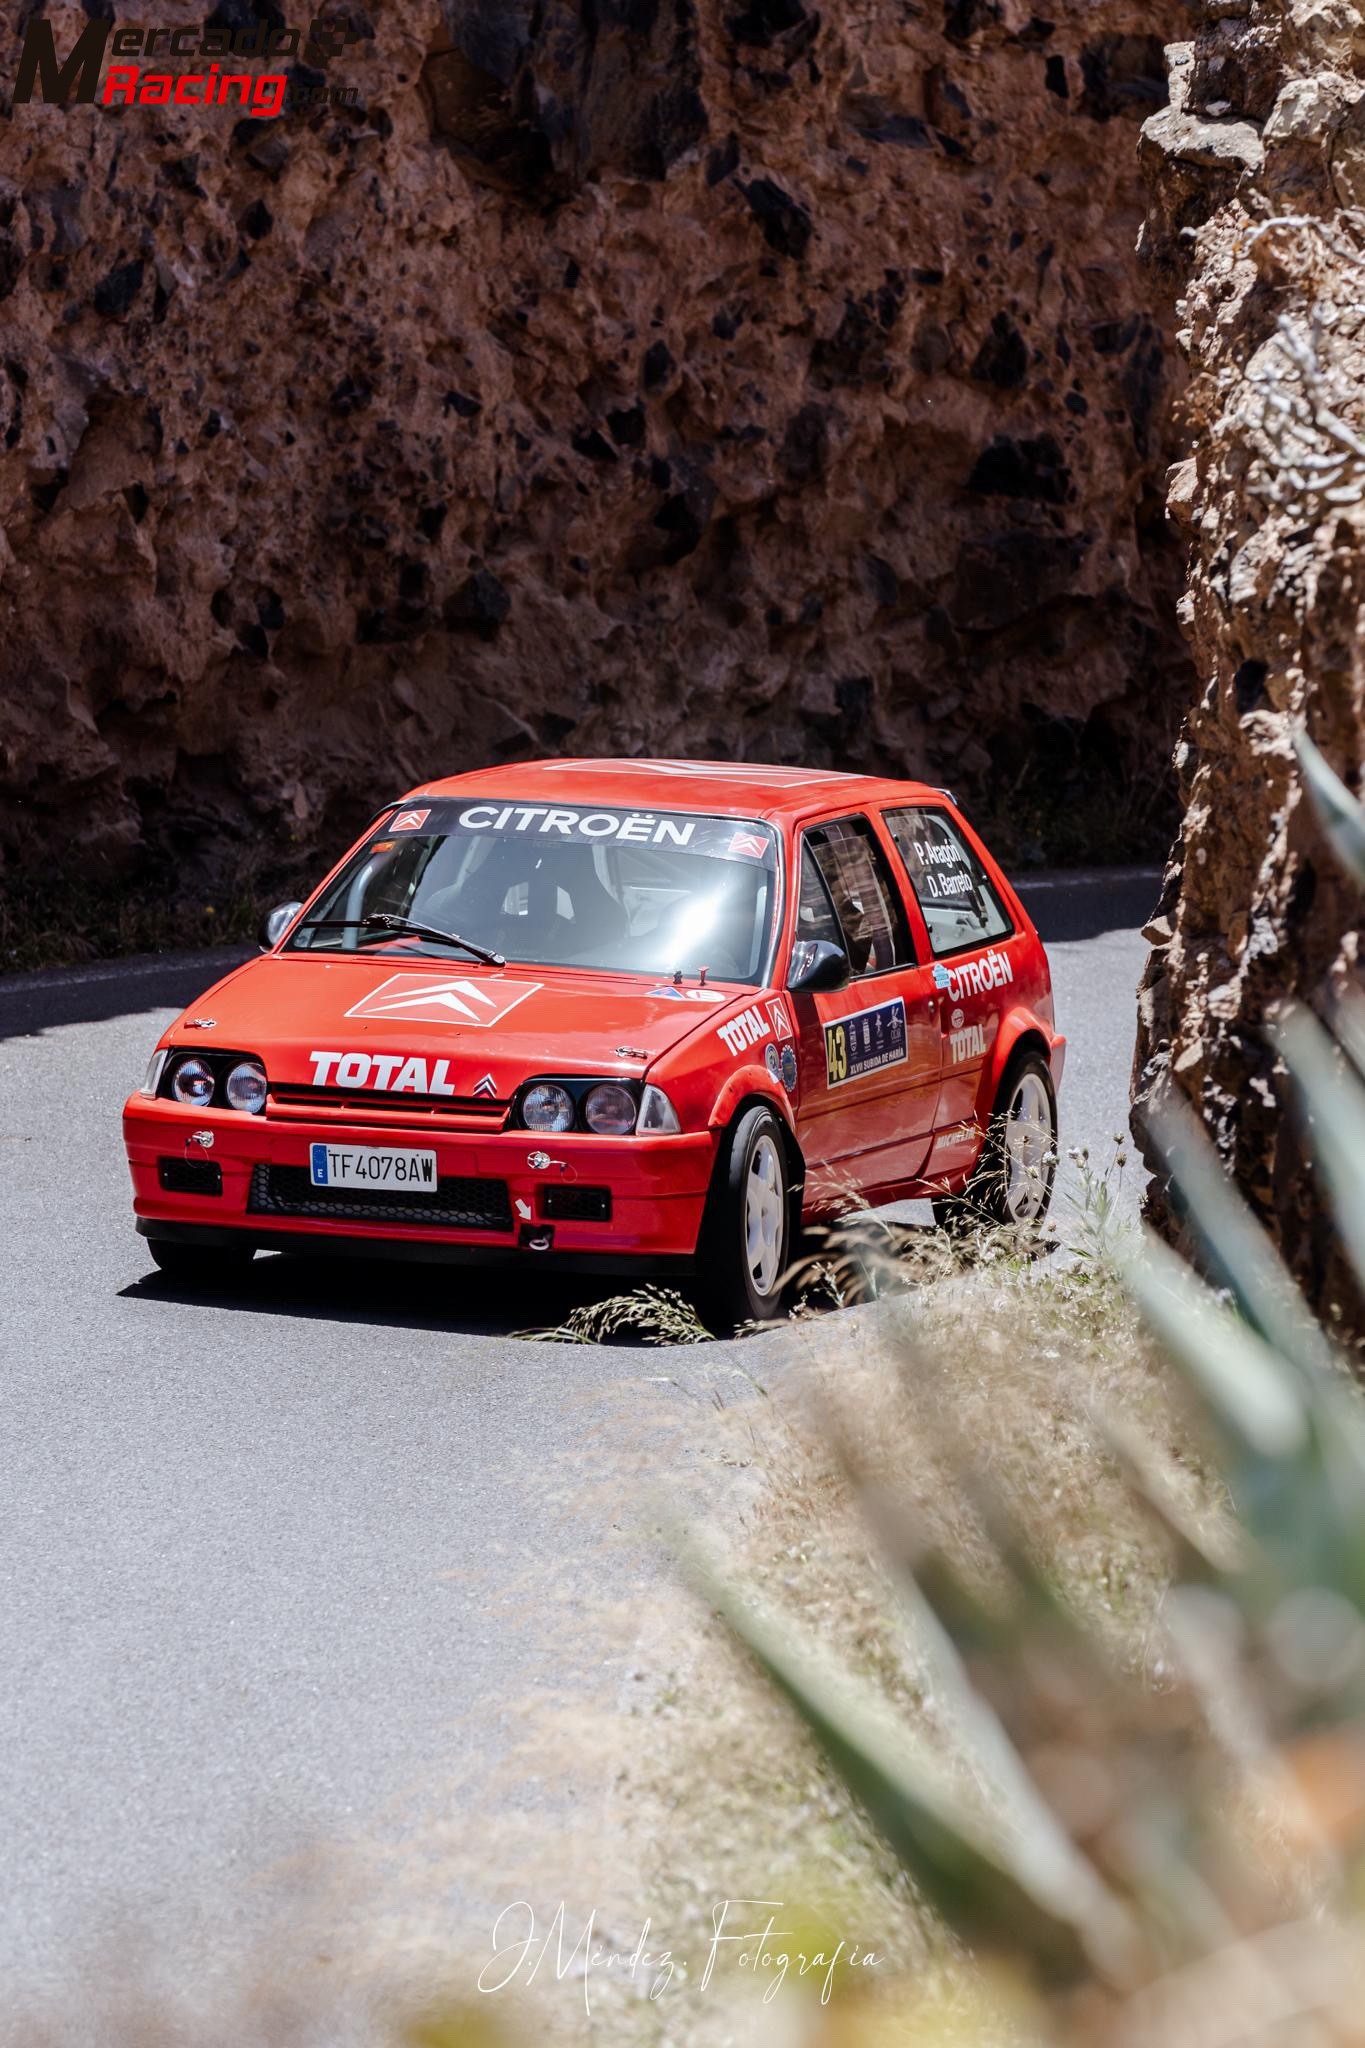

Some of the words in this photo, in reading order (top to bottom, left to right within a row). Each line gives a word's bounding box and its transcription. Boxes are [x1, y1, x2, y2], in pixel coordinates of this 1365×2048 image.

[458, 806, 697, 846] CITROËN
[926, 875, 942, 898] D.
[937, 870, 974, 896] Barreto
[948, 949, 1014, 1002] CITROËN
[716, 1005, 771, 1057] TOTAL
[950, 1023, 987, 1064] TOTAL
[309, 1050, 455, 1096] TOTAL
[827, 1025, 847, 1081] 43
[881, 1052, 889, 1064] DE
[317, 1168, 324, 1178] E
[328, 1153, 433, 1183] TF4078AW
